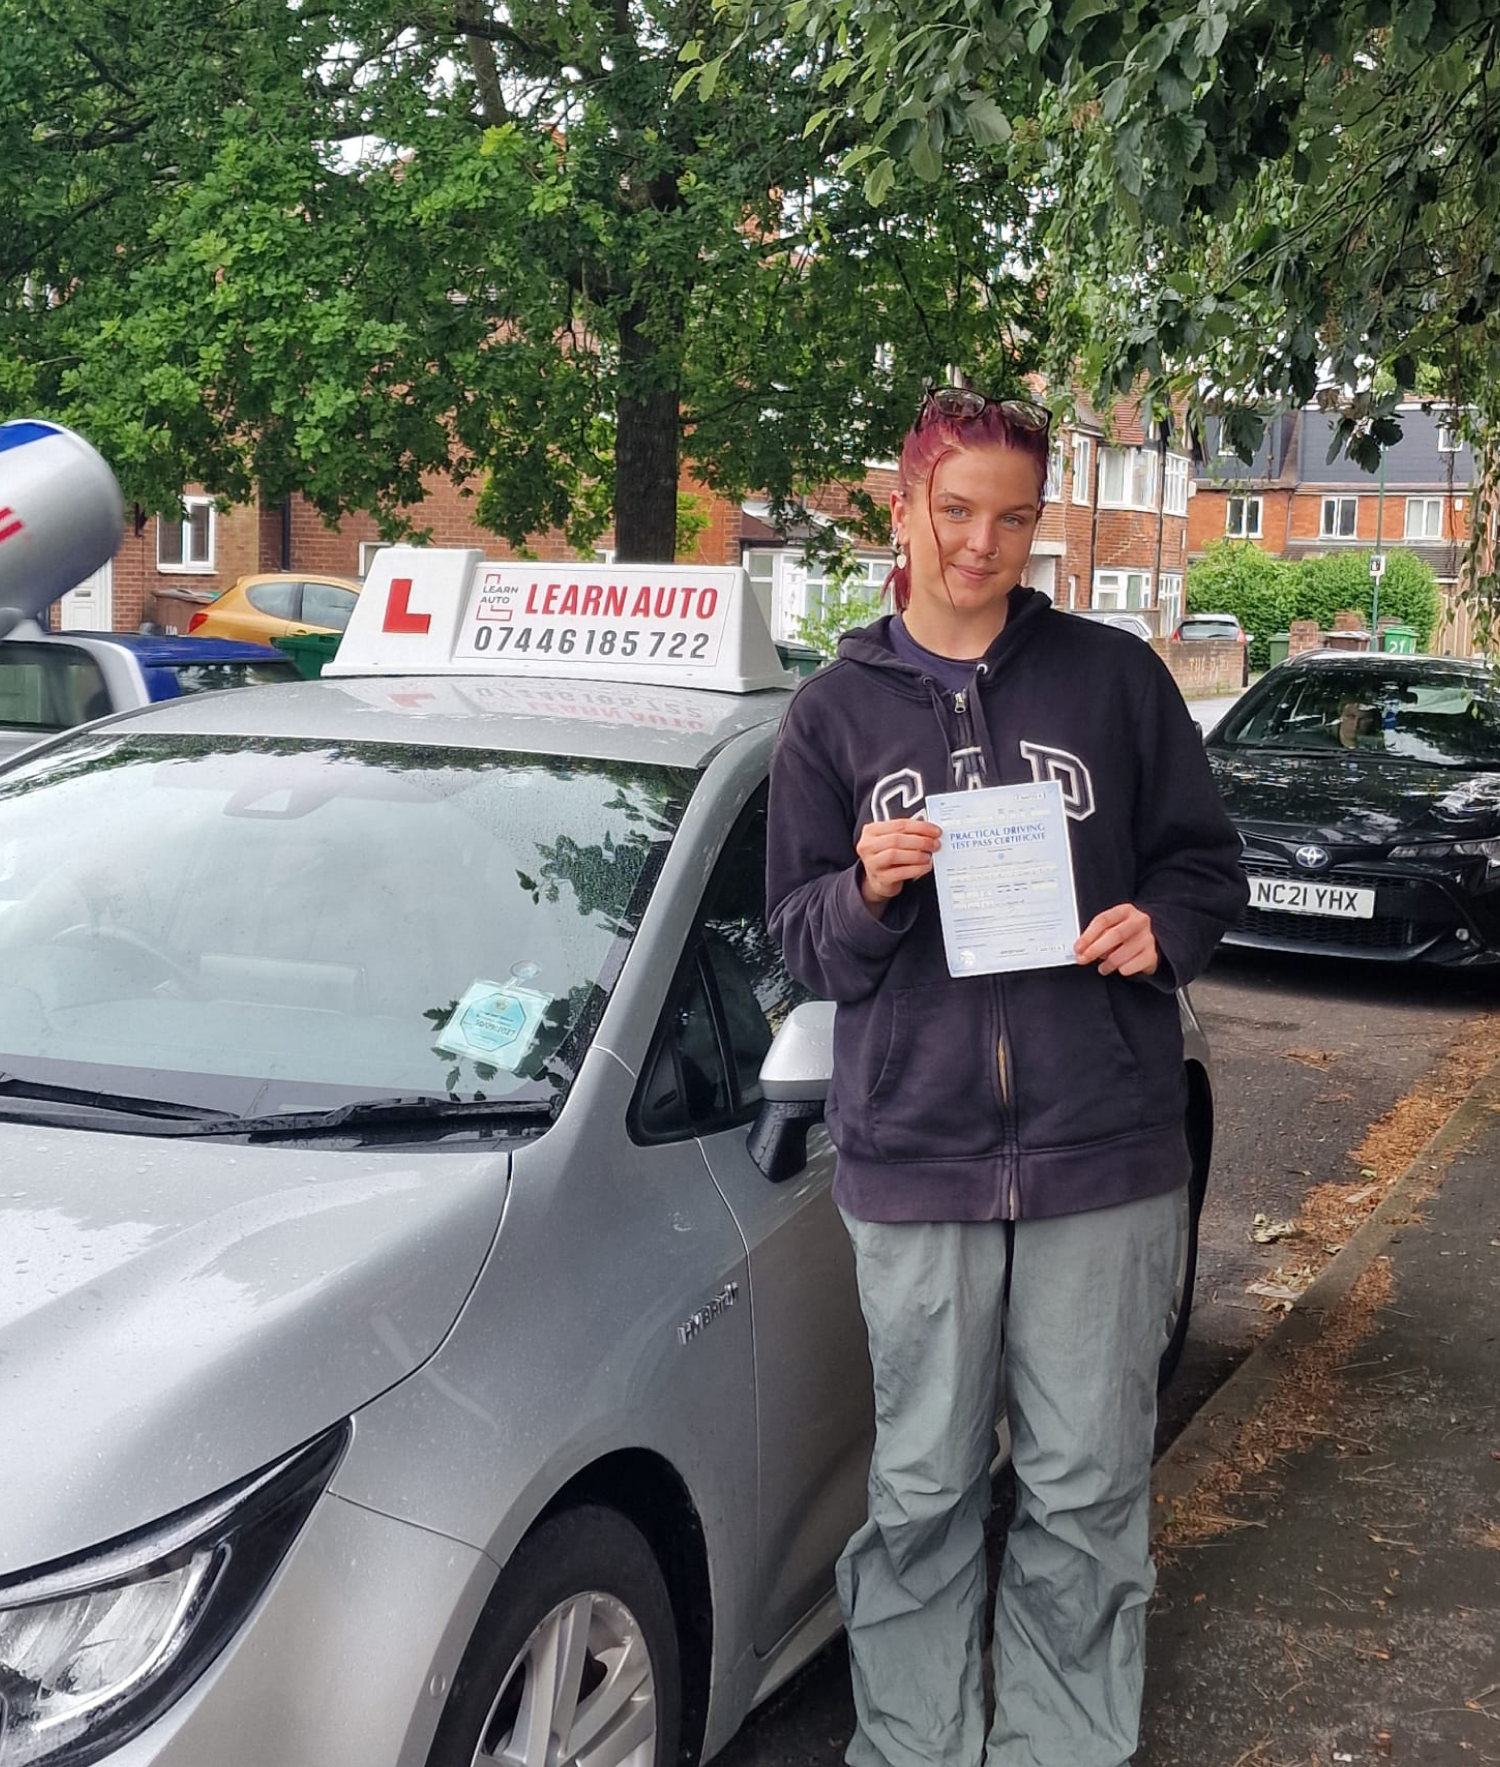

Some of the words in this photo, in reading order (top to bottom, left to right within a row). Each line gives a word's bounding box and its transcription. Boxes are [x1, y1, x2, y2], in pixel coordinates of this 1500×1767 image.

[482, 585, 519, 594] LEARN
[382, 578, 432, 634] L
[480, 596, 511, 605] AUTO
[950, 828, 1000, 841] PRACTICAL
[1003, 823, 1046, 835] DRIVING
[952, 840, 970, 850] TEST
[972, 838, 992, 847] PASS
[994, 832, 1046, 845] CERTIFICATE
[1257, 882, 1308, 906] NC21
[1315, 888, 1359, 912] YHX
